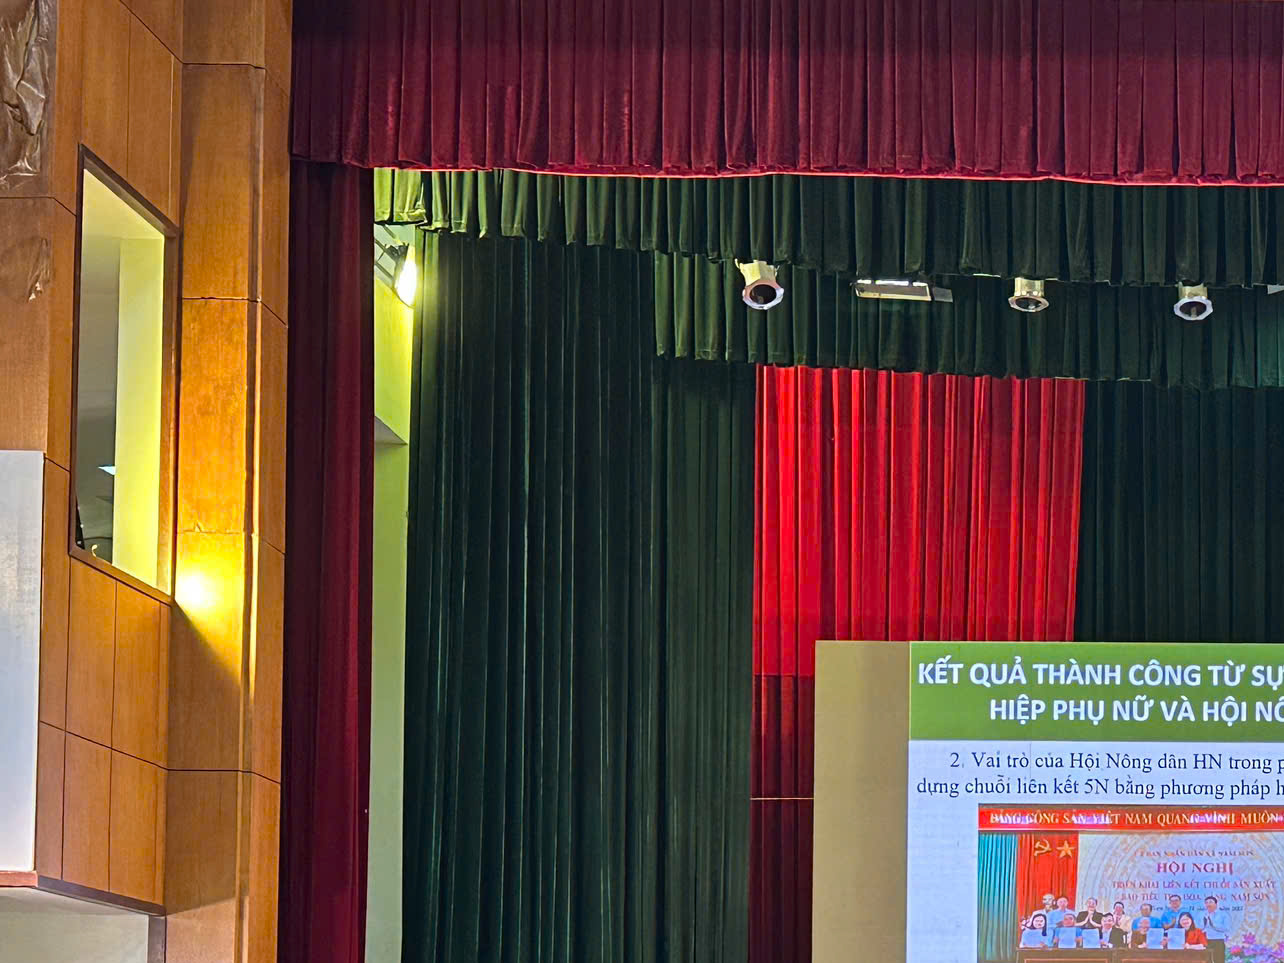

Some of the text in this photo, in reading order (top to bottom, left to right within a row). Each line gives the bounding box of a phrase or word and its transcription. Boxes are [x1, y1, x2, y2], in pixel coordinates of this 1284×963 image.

[918, 655, 963, 684] KẾT
[970, 656, 1026, 687] QUẢ
[1033, 659, 1120, 685] THÀNH
[1128, 659, 1201, 686] CÔNG
[1208, 660, 1245, 686] TỪ
[990, 694, 1045, 724] HIỆP
[1053, 699, 1104, 725] PHỤ
[1113, 695, 1154, 721] NỮ
[1160, 696, 1195, 721] VÀ
[1203, 696, 1246, 726] HỘI
[950, 752, 965, 768] 2.
[972, 752, 1000, 768] Vai
[1007, 752, 1028, 768] trò
[1035, 753, 1064, 768] của
[1070, 752, 1100, 772] Hội
[1106, 752, 1151, 772] Nông
[1158, 754, 1186, 769] dân
[1193, 755, 1222, 769] HN
[1229, 756, 1271, 773] trong
[917, 778, 959, 796] dựng
[965, 774, 1010, 794] chuỗi
[1017, 777, 1046, 794] liên
[1054, 775, 1079, 794] kết
[1085, 779, 1108, 794] 5N
[1115, 775, 1154, 798] bằng
[1161, 780, 1224, 799] phương
[1230, 780, 1270, 799] pháp
[1125, 813, 1152, 824] NAM
[1157, 862, 1233, 874] HỘI NGHỊ
